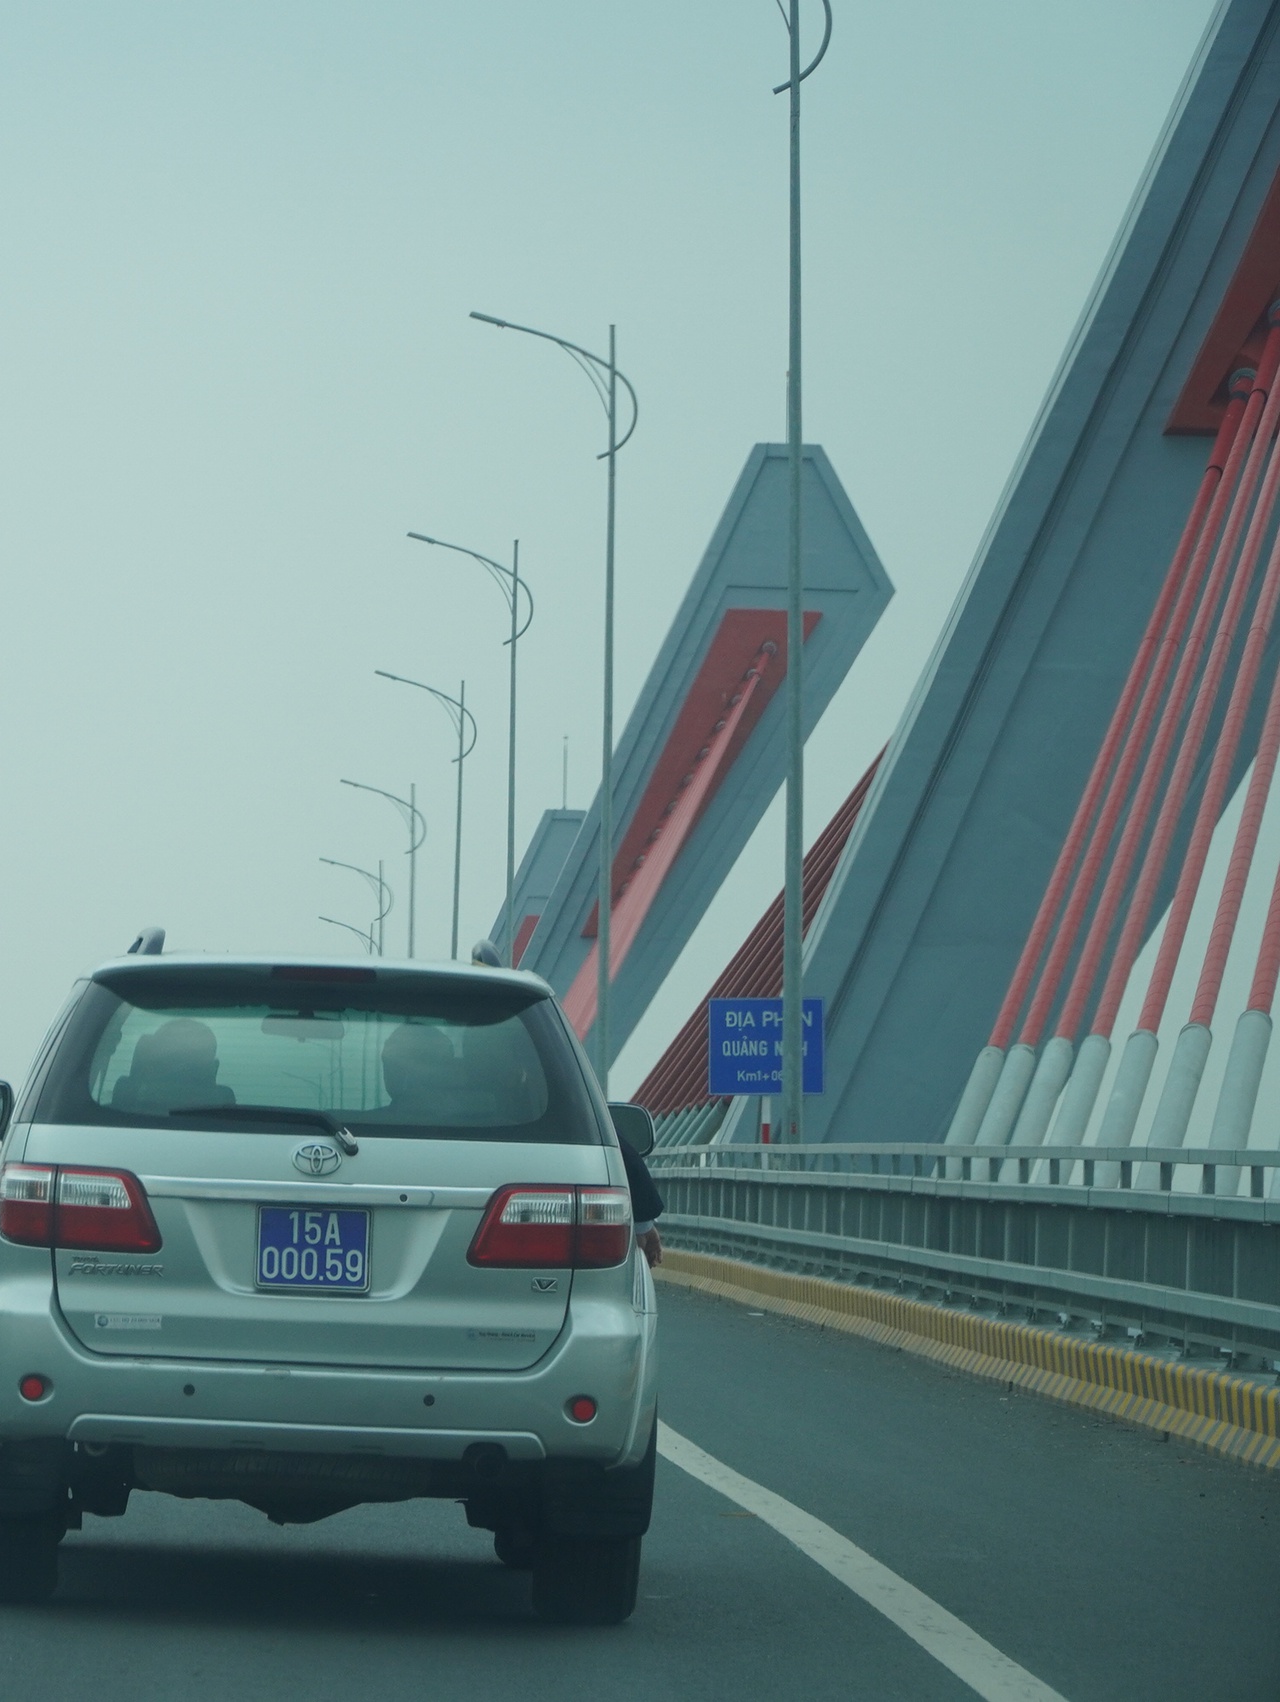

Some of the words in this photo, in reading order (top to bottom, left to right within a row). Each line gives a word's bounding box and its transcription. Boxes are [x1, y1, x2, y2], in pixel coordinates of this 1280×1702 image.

[725, 1011, 755, 1031] ĐỊA
[762, 1011, 812, 1027] PHN
[722, 1036, 768, 1056] QUẢNG
[289, 1211, 341, 1245] 15A
[68, 1262, 164, 1277] FORTUNER
[262, 1246, 363, 1282] 000.59
